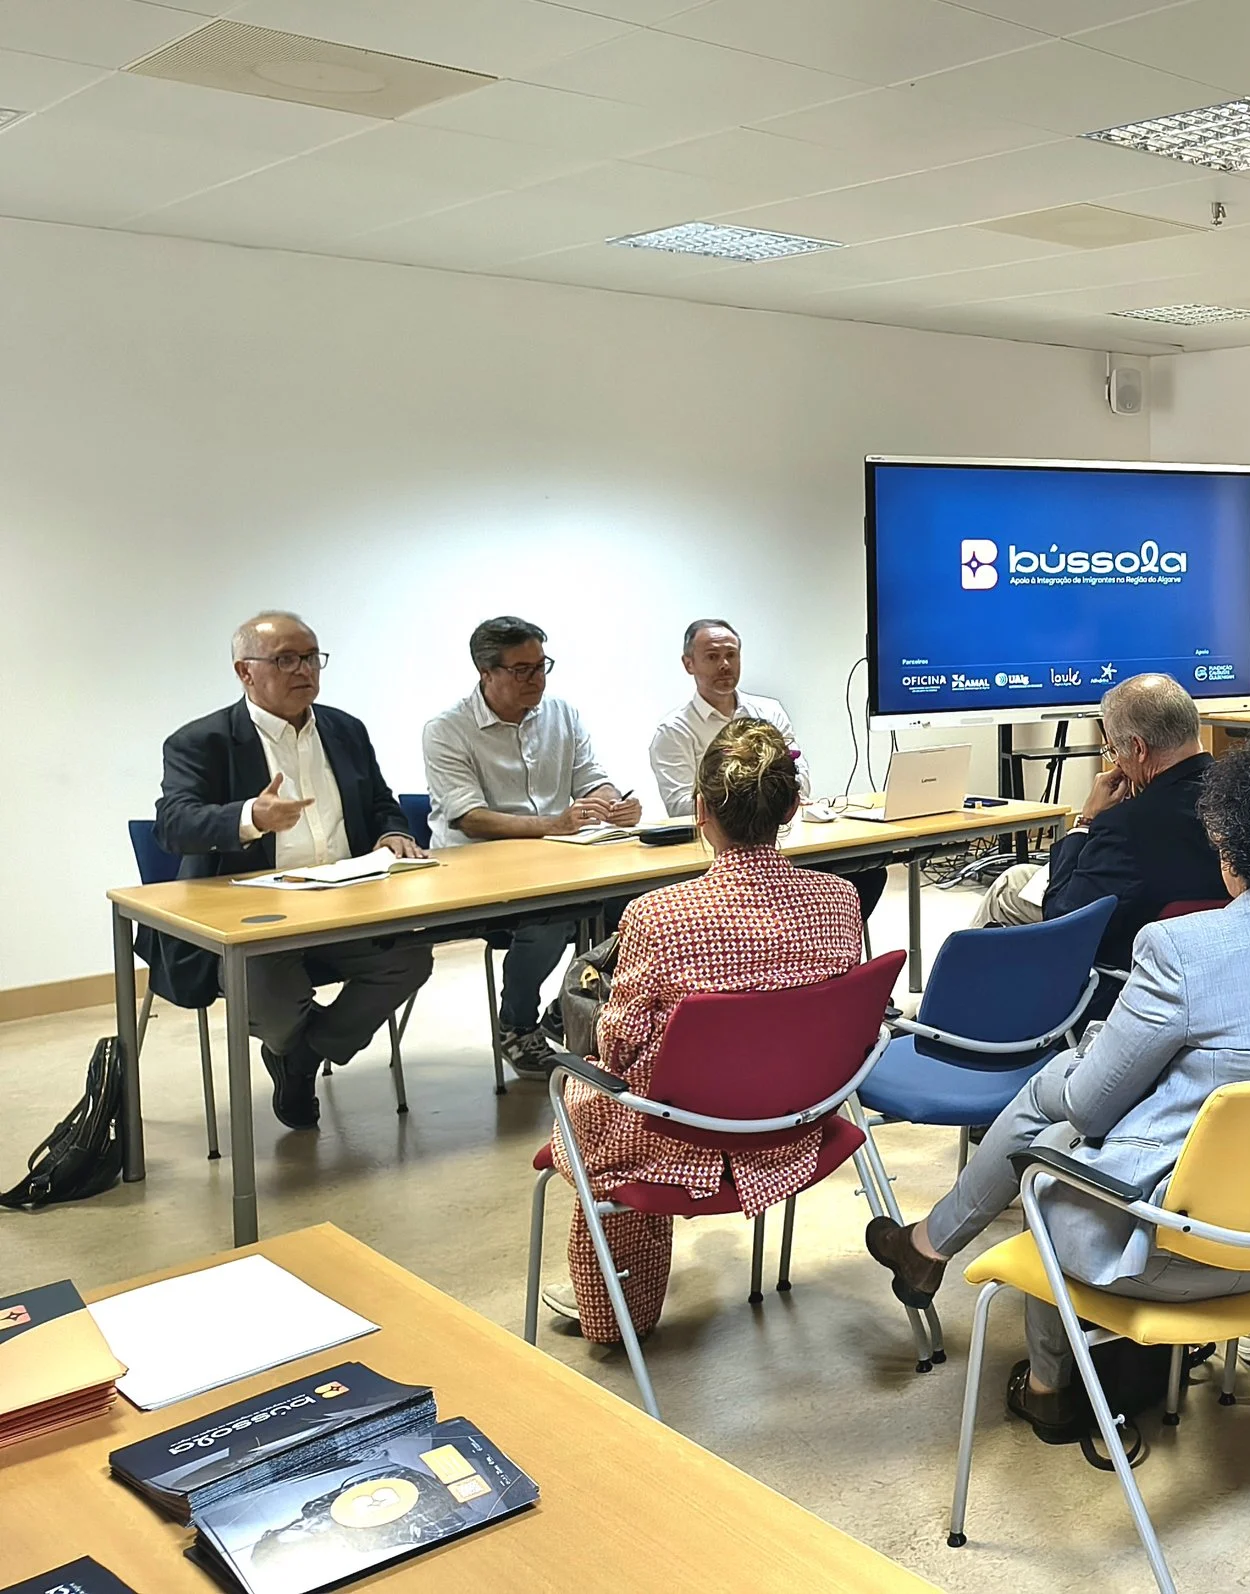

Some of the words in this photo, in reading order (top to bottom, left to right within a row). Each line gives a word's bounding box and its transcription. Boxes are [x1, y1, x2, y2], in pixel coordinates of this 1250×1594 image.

[1009, 540, 1187, 573] bússola
[1010, 577, 1030, 586] Apoio
[902, 675, 947, 686] OFICINA
[964, 679, 990, 687] AMAL
[168, 1396, 316, 1456] bússola
